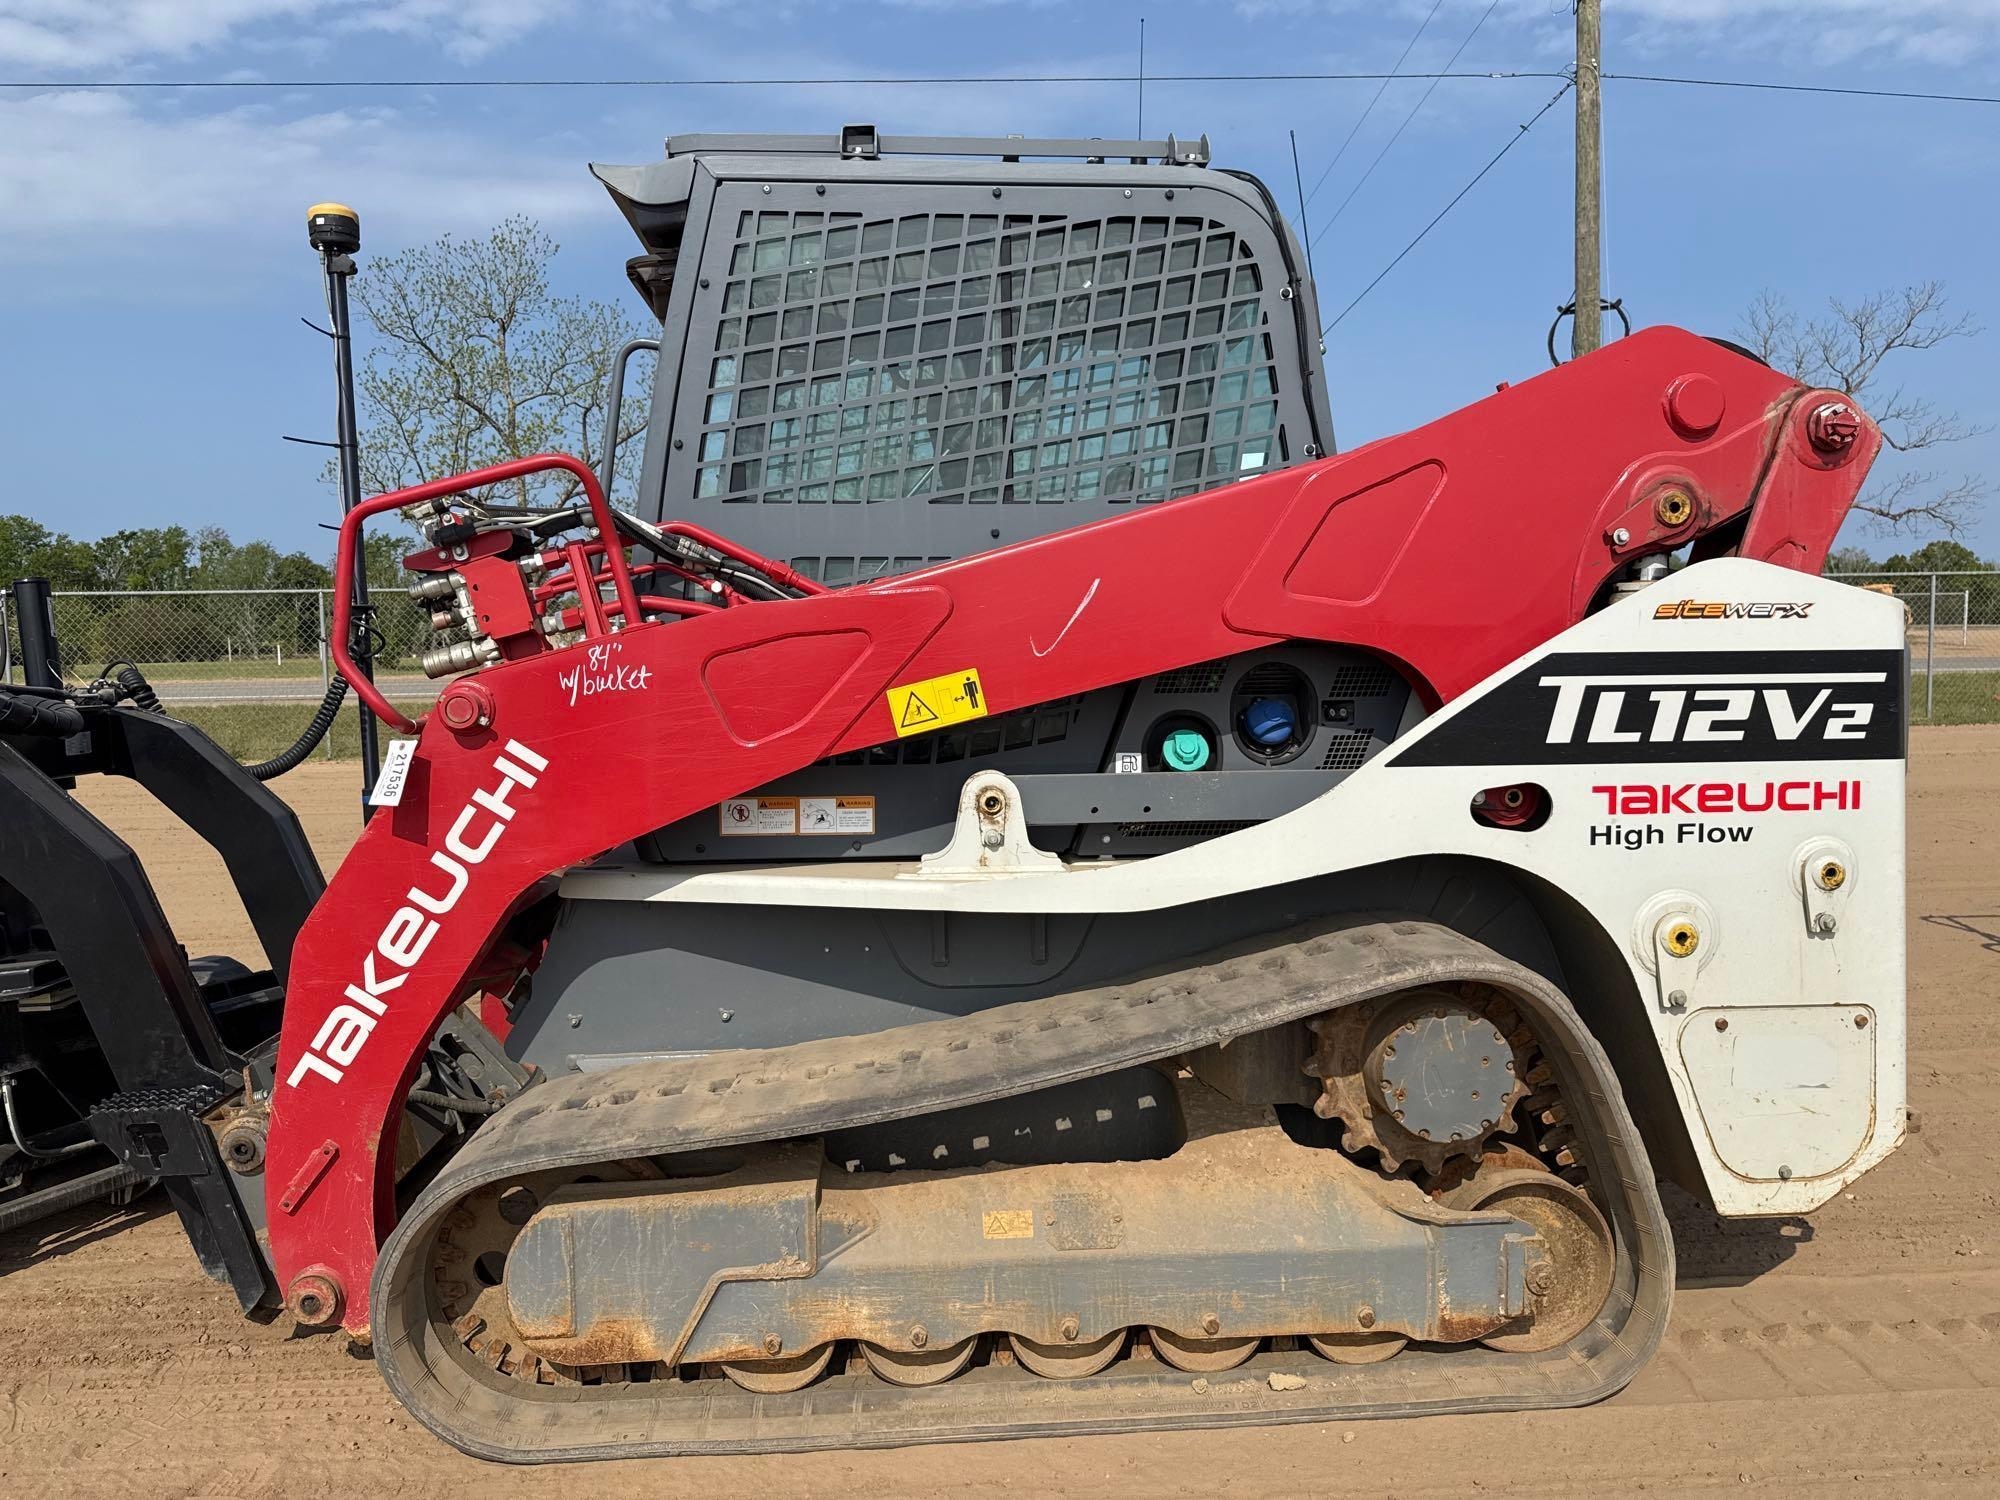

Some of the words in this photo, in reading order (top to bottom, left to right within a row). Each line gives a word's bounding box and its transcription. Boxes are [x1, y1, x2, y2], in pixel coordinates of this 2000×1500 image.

[1652, 599, 1816, 620] sitewerx
[1538, 672, 1888, 744] TL12V2
[383, 753, 408, 797] 217536
[1591, 780, 1861, 815] TAKEUCHI
[1589, 824, 1665, 850] High
[1676, 823, 1754, 844] Flow
[286, 738, 550, 1089] TAKEUCHI
